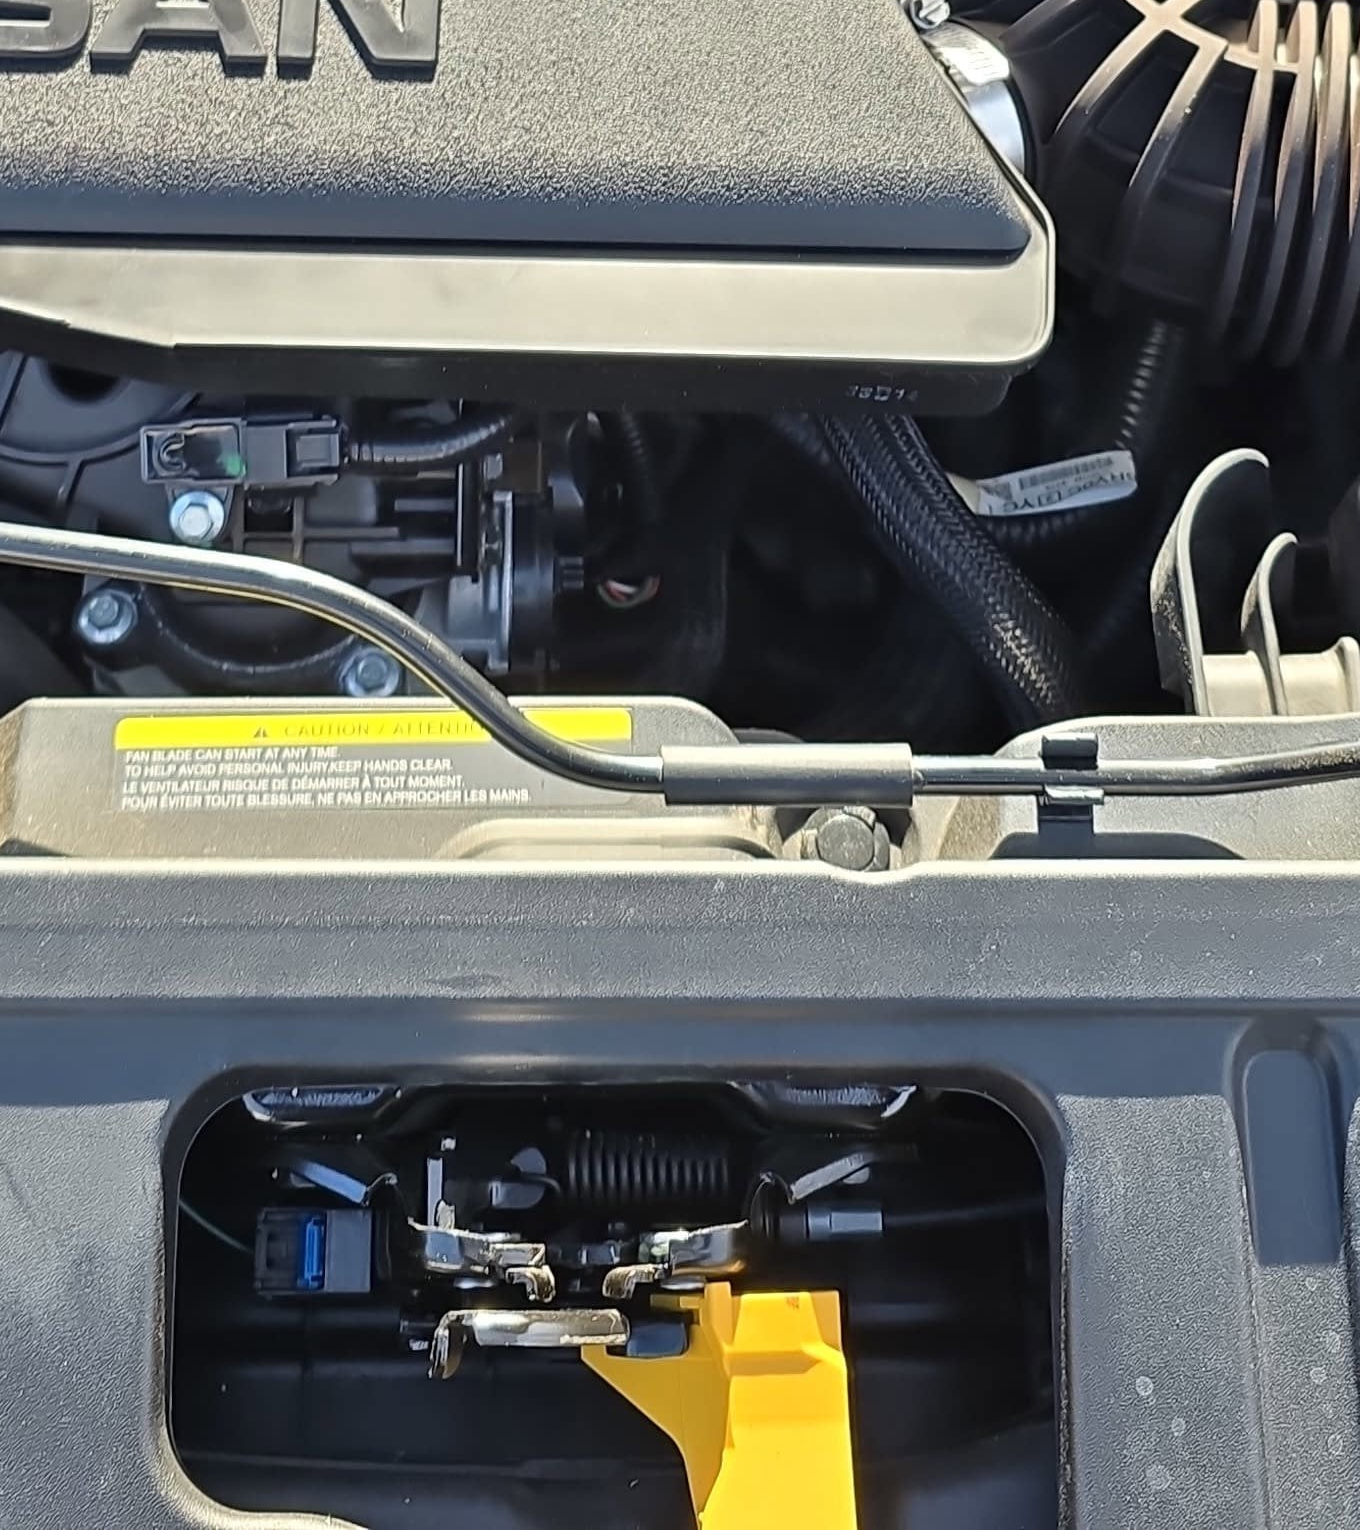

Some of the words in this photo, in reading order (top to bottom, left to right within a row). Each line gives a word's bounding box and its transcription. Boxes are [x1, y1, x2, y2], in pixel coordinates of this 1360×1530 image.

[284, 723, 369, 737] CAUTION
[125, 750, 150, 763] FAN
[152, 749, 192, 761] BLADE
[195, 748, 223, 761] CAN
[225, 748, 262, 760] START
[265, 748, 280, 760] AT
[283, 746, 309, 760] ANY
[311, 746, 340, 759] TIME.
[125, 765, 141, 778] TO
[144, 764, 177, 778] HELP
[178, 763, 216, 777] AVOID
[219, 762, 284, 775] PERSONAL
[364, 759, 407, 771] HANDS
[411, 758, 452, 771] CLEAR.
[123, 781, 139, 793] LE
[141, 779, 220, 793] VENTILATEUR
[223, 779, 270, 792] RISQUE
[272, 778, 289, 791] DE
[292, 774, 359, 791] DÉMARRER
[362, 773, 371, 788] À
[374, 775, 406, 788] TOUT
[408, 775, 465, 788] MOMENT.
[122, 796, 158, 810] POUR
[160, 793, 201, 809] ÉVITER
[204, 794, 244, 808] TOUTE
[246, 793, 314, 808] BLESSURE,
[318, 792, 335, 805] NE
[337, 791, 361, 805] PAS
[364, 791, 381, 804] EN
[384, 789, 461, 804] APPROCHER
[464, 788, 487, 802] LES
[490, 787, 531, 801] MAINS.
